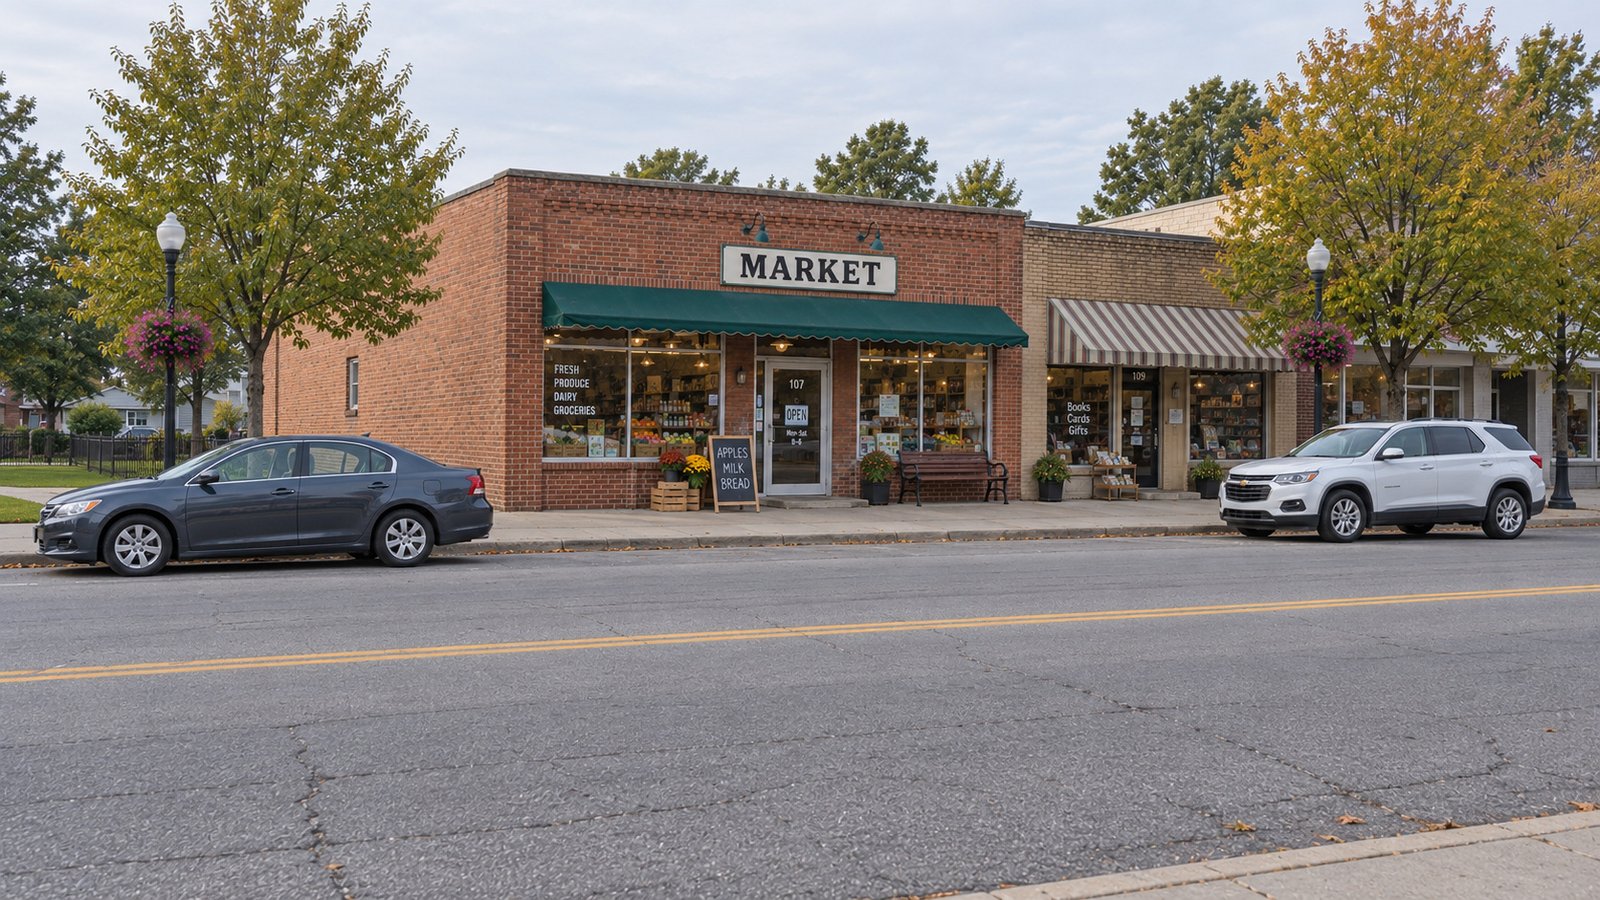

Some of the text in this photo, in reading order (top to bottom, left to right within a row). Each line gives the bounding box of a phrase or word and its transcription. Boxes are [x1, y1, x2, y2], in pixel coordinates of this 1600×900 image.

[740, 253, 880, 286] MARKET
[554, 364, 579, 374] FRESH
[1133, 372, 1146, 380] 109
[554, 378, 590, 388] PRODUCE
[790, 379, 804, 389] 107
[554, 392, 577, 401] DAIRY
[554, 406, 596, 415] GROCERIES
[1067, 402, 1090, 412] Books
[787, 409, 806, 420] OPEN
[1067, 414, 1090, 423] Cards
[1068, 425, 1088, 435] Gifts
[717, 447, 748, 458] APPLES
[723, 463, 745, 474] MILK
[721, 478, 750, 490] BREAD
